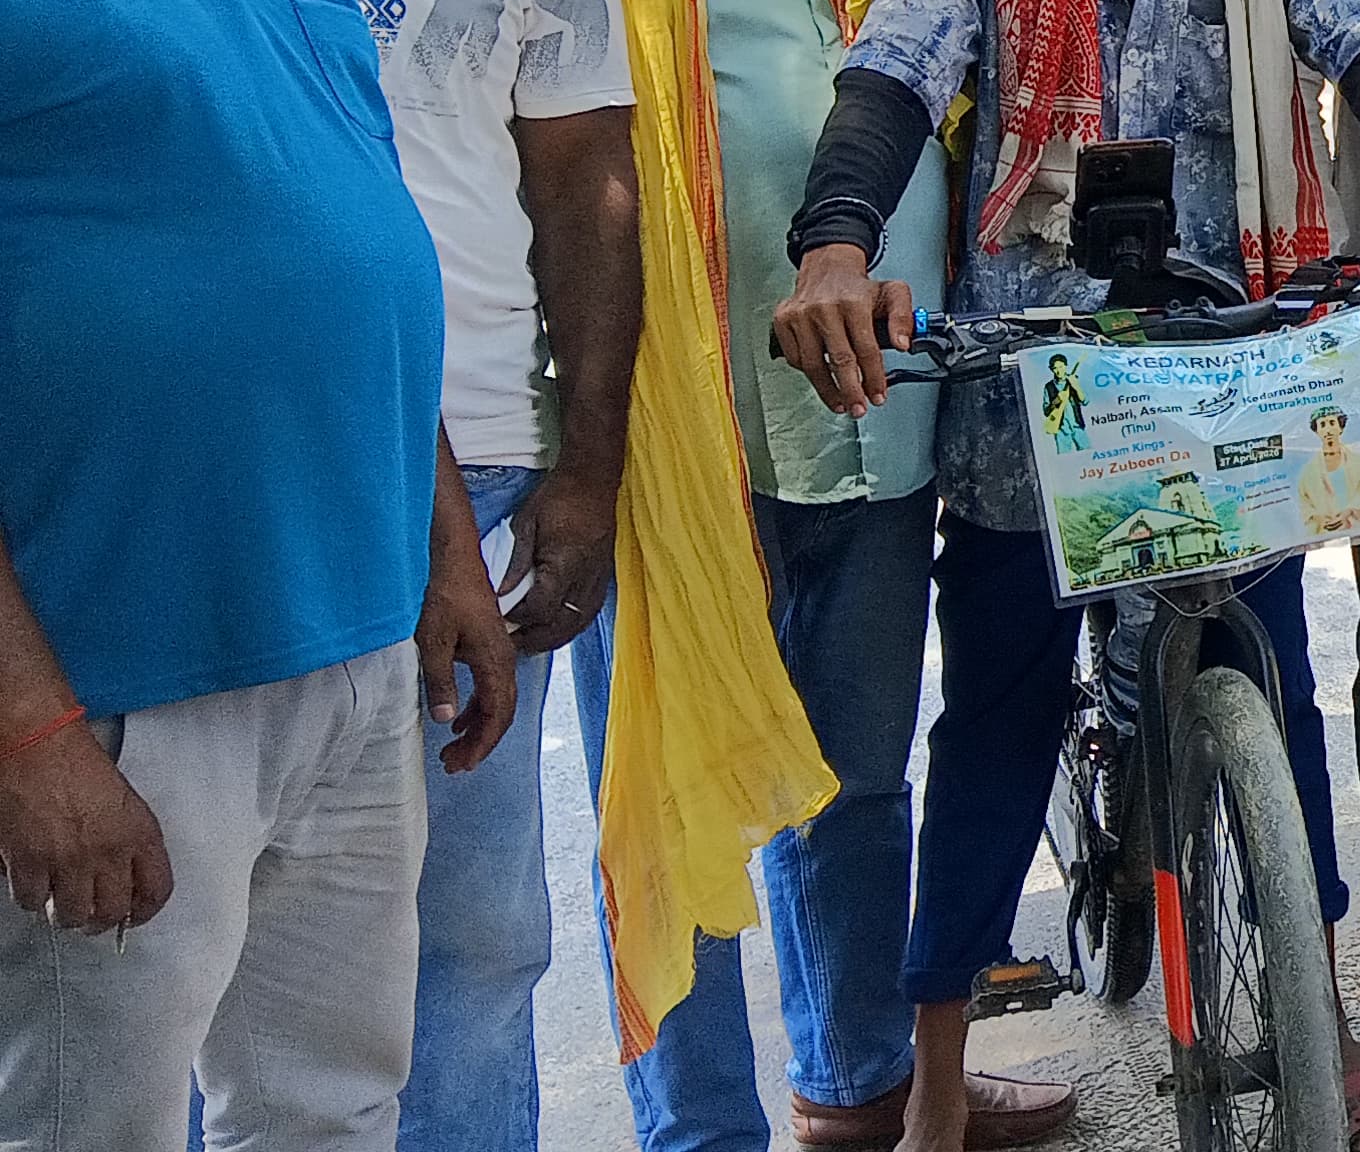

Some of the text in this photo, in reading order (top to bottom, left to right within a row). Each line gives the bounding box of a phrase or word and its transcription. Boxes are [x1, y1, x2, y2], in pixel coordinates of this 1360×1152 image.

[1128, 349, 1266, 368] KEDARNATH
[1173, 369, 1246, 385] YATRA
[1254, 354, 1303, 376] 2026
[1308, 376, 1344, 389] Dham
[1118, 394, 1150, 405] From
[1258, 393, 1333, 413] Uttarakhand
[1091, 405, 1182, 425] Nalbari, Assam
[1092, 446, 1129, 460] Assam
[1132, 440, 1165, 452] Kings
[1079, 451, 1190, 480] Jay Zubeen Da
